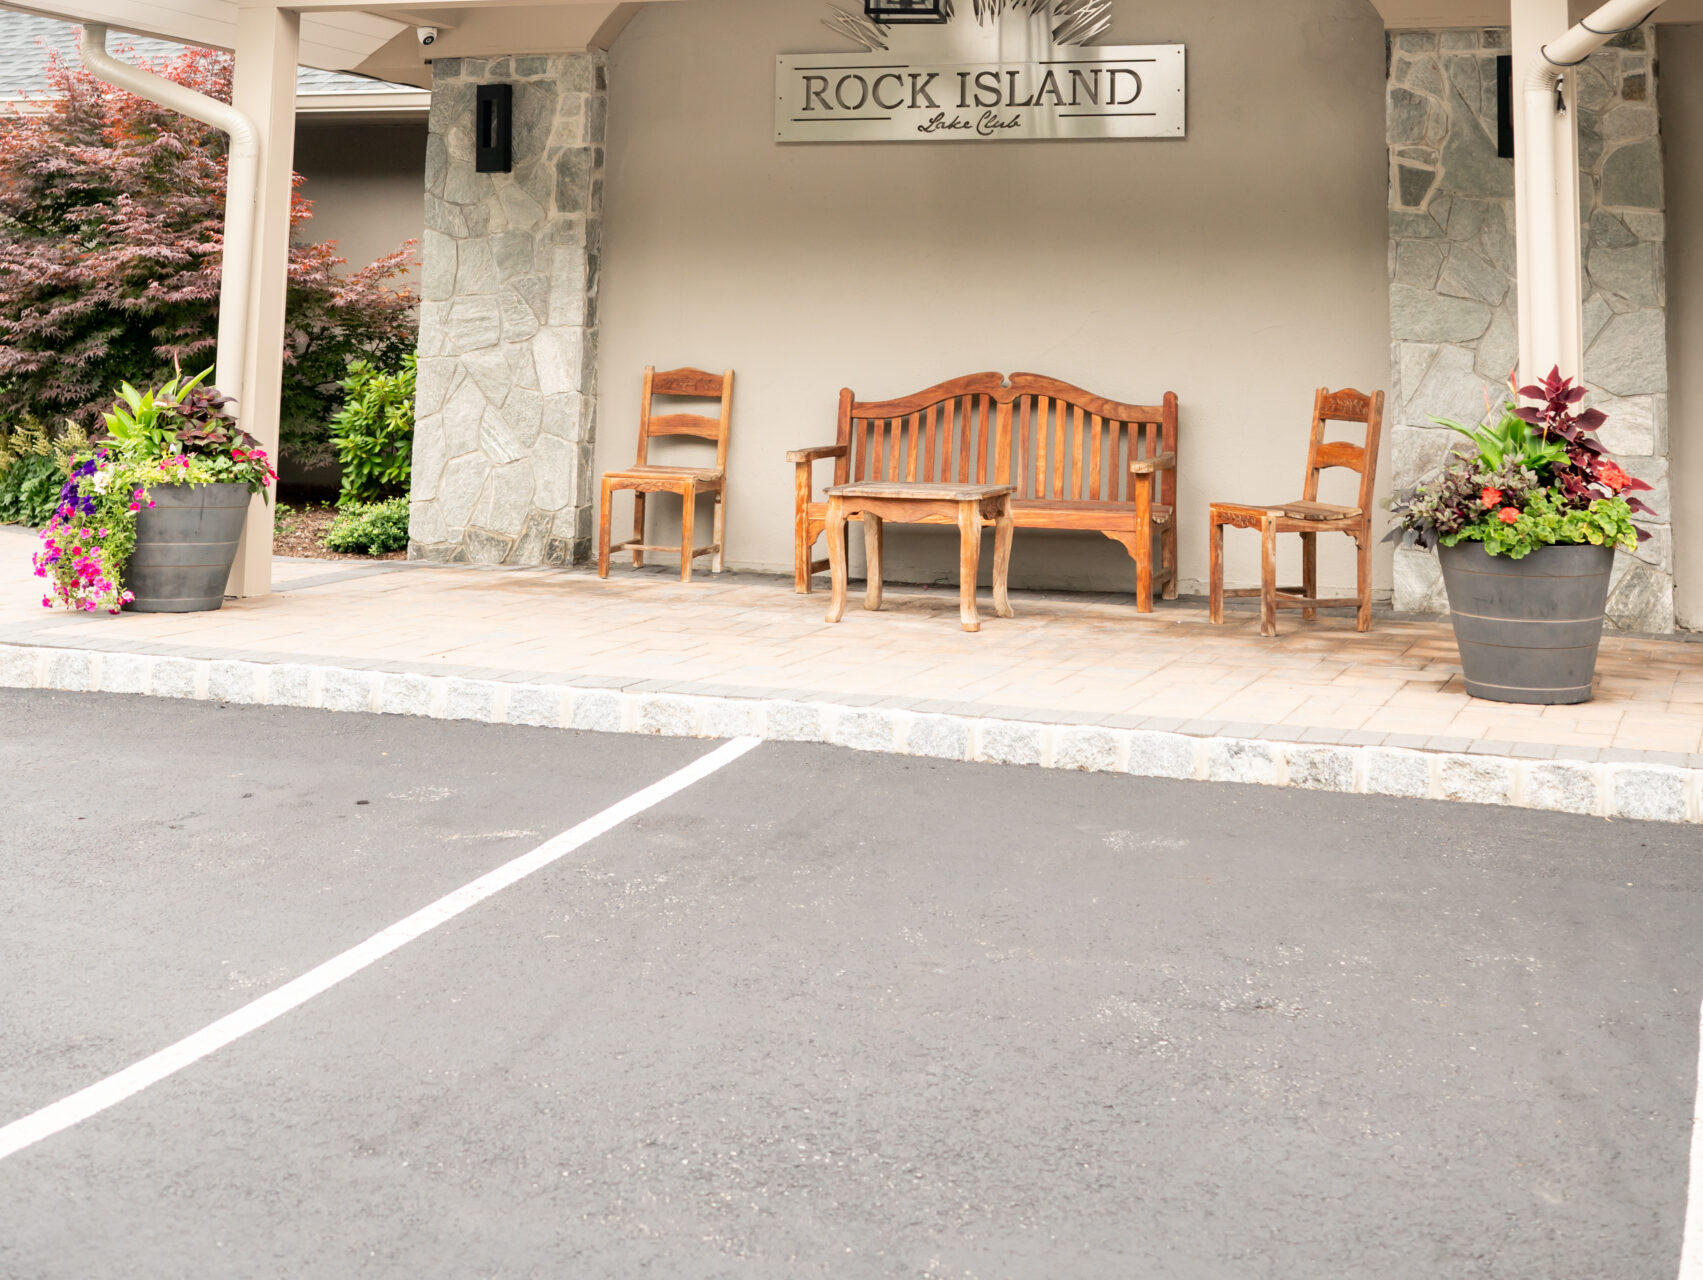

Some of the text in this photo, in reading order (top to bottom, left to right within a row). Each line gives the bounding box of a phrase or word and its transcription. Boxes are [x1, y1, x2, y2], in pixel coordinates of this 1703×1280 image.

[802, 68, 1142, 111] ROCK ISLAND
[917, 110, 1021, 136] Lake Club
